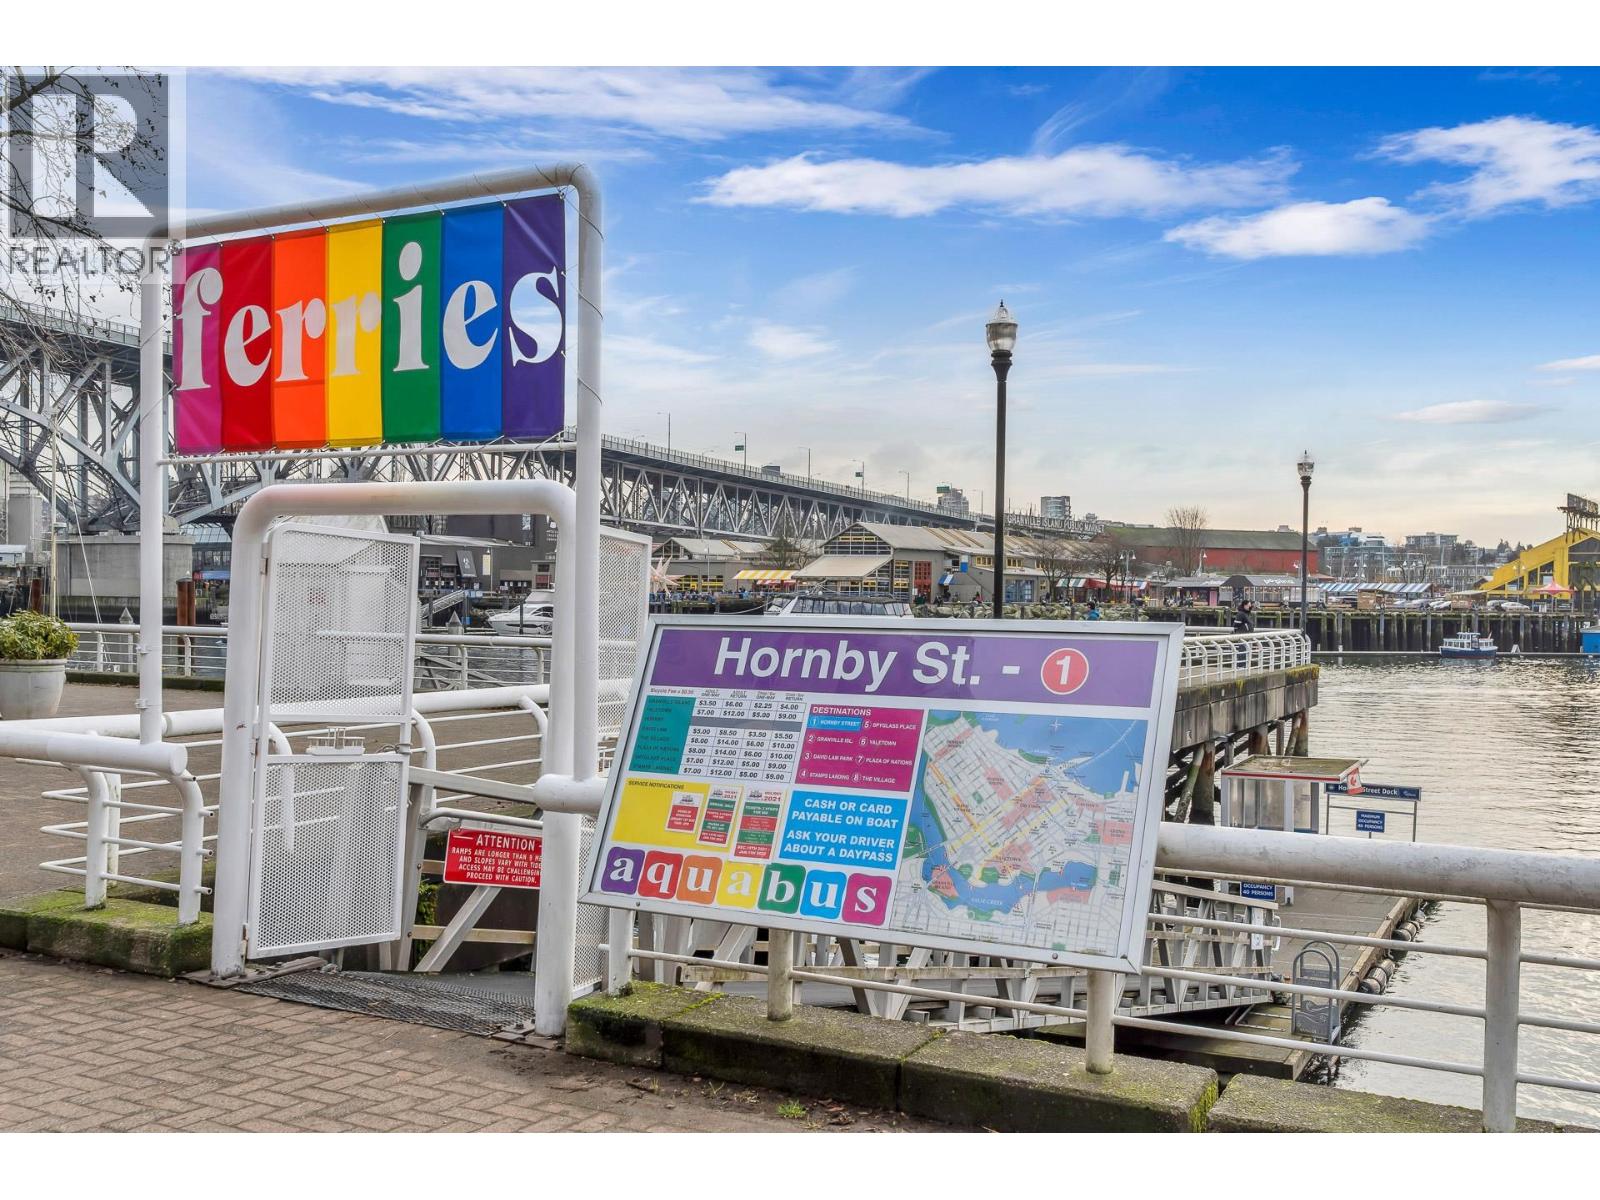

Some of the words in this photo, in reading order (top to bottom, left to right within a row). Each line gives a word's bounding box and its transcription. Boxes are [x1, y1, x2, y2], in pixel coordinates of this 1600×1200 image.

[175, 241, 565, 391] ferries
[714, 636, 897, 692] Hornby
[912, 640, 980, 685] St.
[1056, 655, 1073, 685] 1
[812, 706, 872, 716] DESTINATIONS
[804, 799, 836, 810] CASH
[840, 801, 856, 811] OR
[860, 803, 892, 814] CARD
[792, 811, 842, 824] PAYABLE
[846, 815, 863, 825] ON
[866, 818, 898, 828] BOAT
[476, 834, 535, 851] ATTENTION
[787, 830, 811, 840] ASK
[815, 832, 847, 844] YOUR
[850, 836, 894, 848] DRIVER
[452, 847, 472, 855] RAMPS
[784, 843, 825, 855] ABOUT
[828, 848, 836, 856] A
[840, 849, 893, 862] DAYPASS
[466, 872, 492, 880] PROCEED
[511, 875, 537, 883] CAUTION.
[507, 868, 541, 876] CHALLENGIN
[609, 855, 878, 913] aquabus
